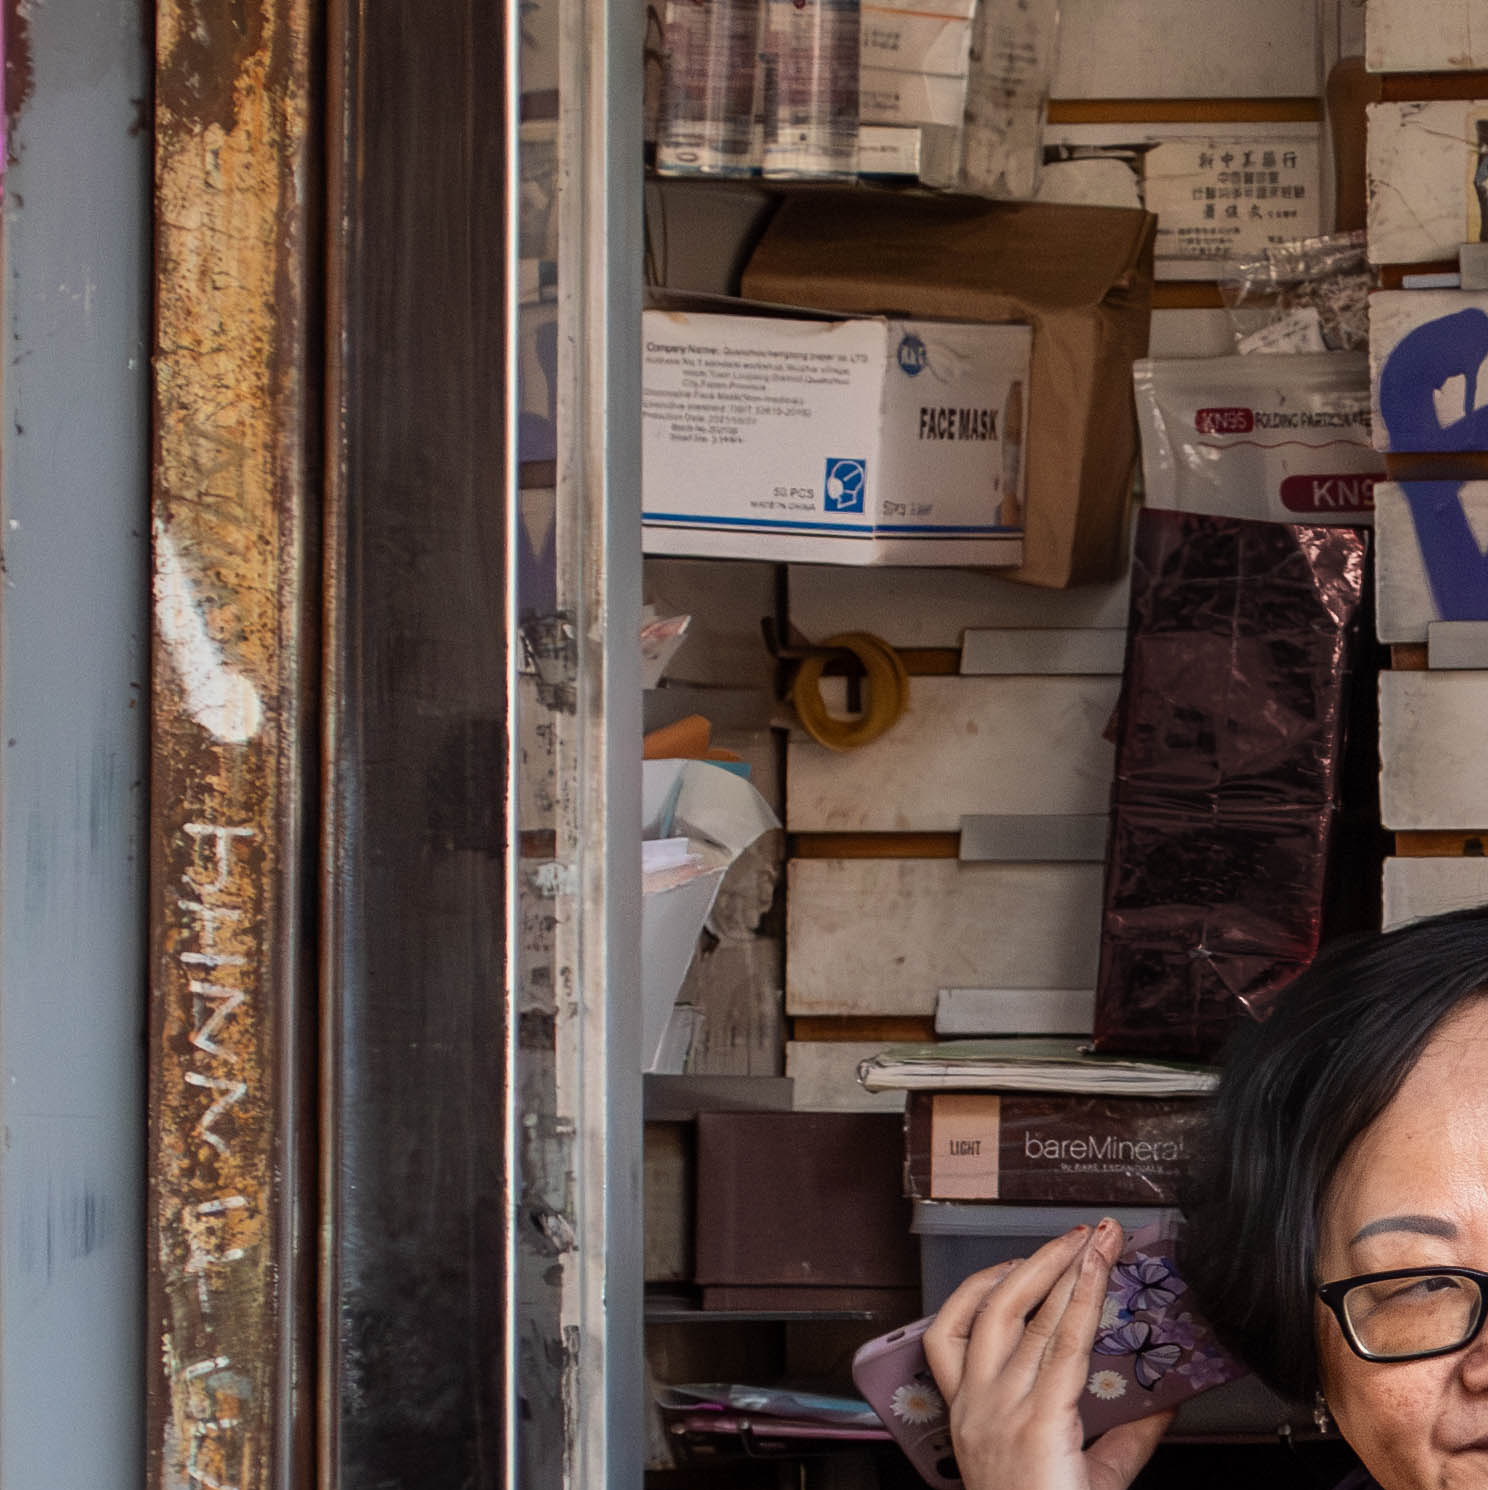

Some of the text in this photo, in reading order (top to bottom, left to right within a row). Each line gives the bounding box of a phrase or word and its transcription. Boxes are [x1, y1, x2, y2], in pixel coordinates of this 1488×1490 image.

[919, 408, 999, 441] FACE MASK
[1202, 411, 1248, 429] KN95
[790, 487, 815, 500] PCS
[950, 1139, 982, 1156] LIGHT
